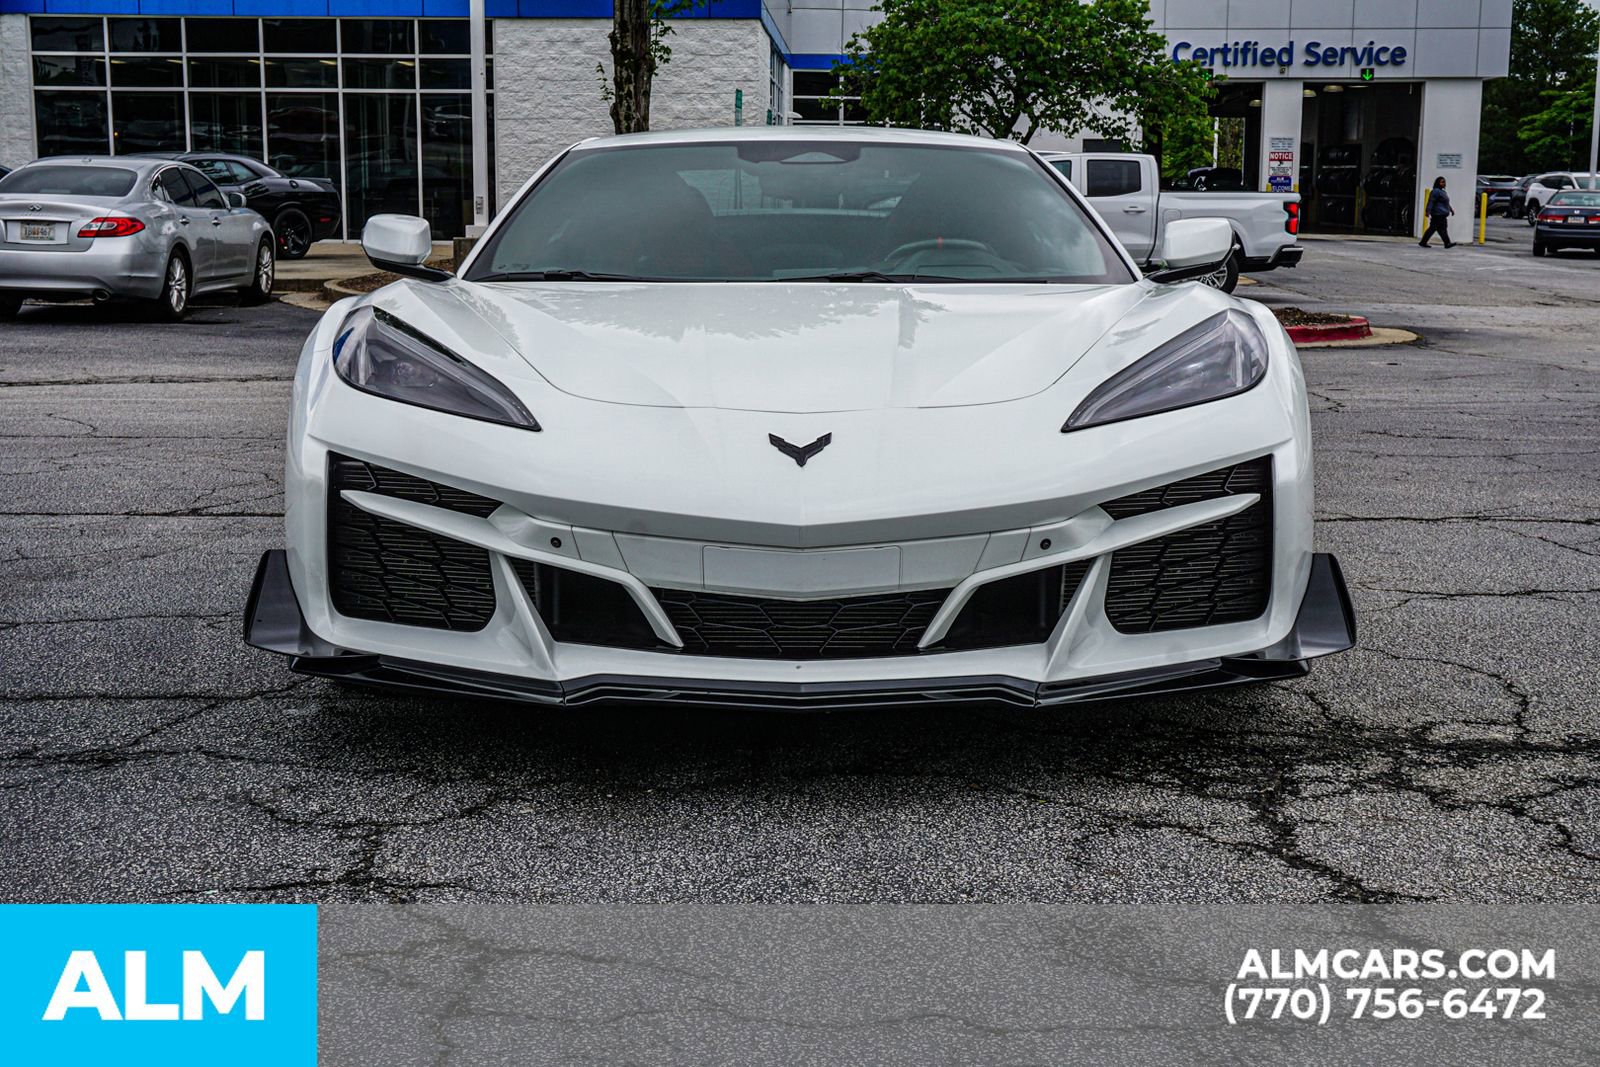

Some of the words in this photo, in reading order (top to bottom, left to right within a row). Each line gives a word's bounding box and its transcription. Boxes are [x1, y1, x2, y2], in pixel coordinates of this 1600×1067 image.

[1172, 41, 1294, 66] Certified
[1303, 41, 1407, 66] Service
[1269, 152, 1293, 160] NOTICE
